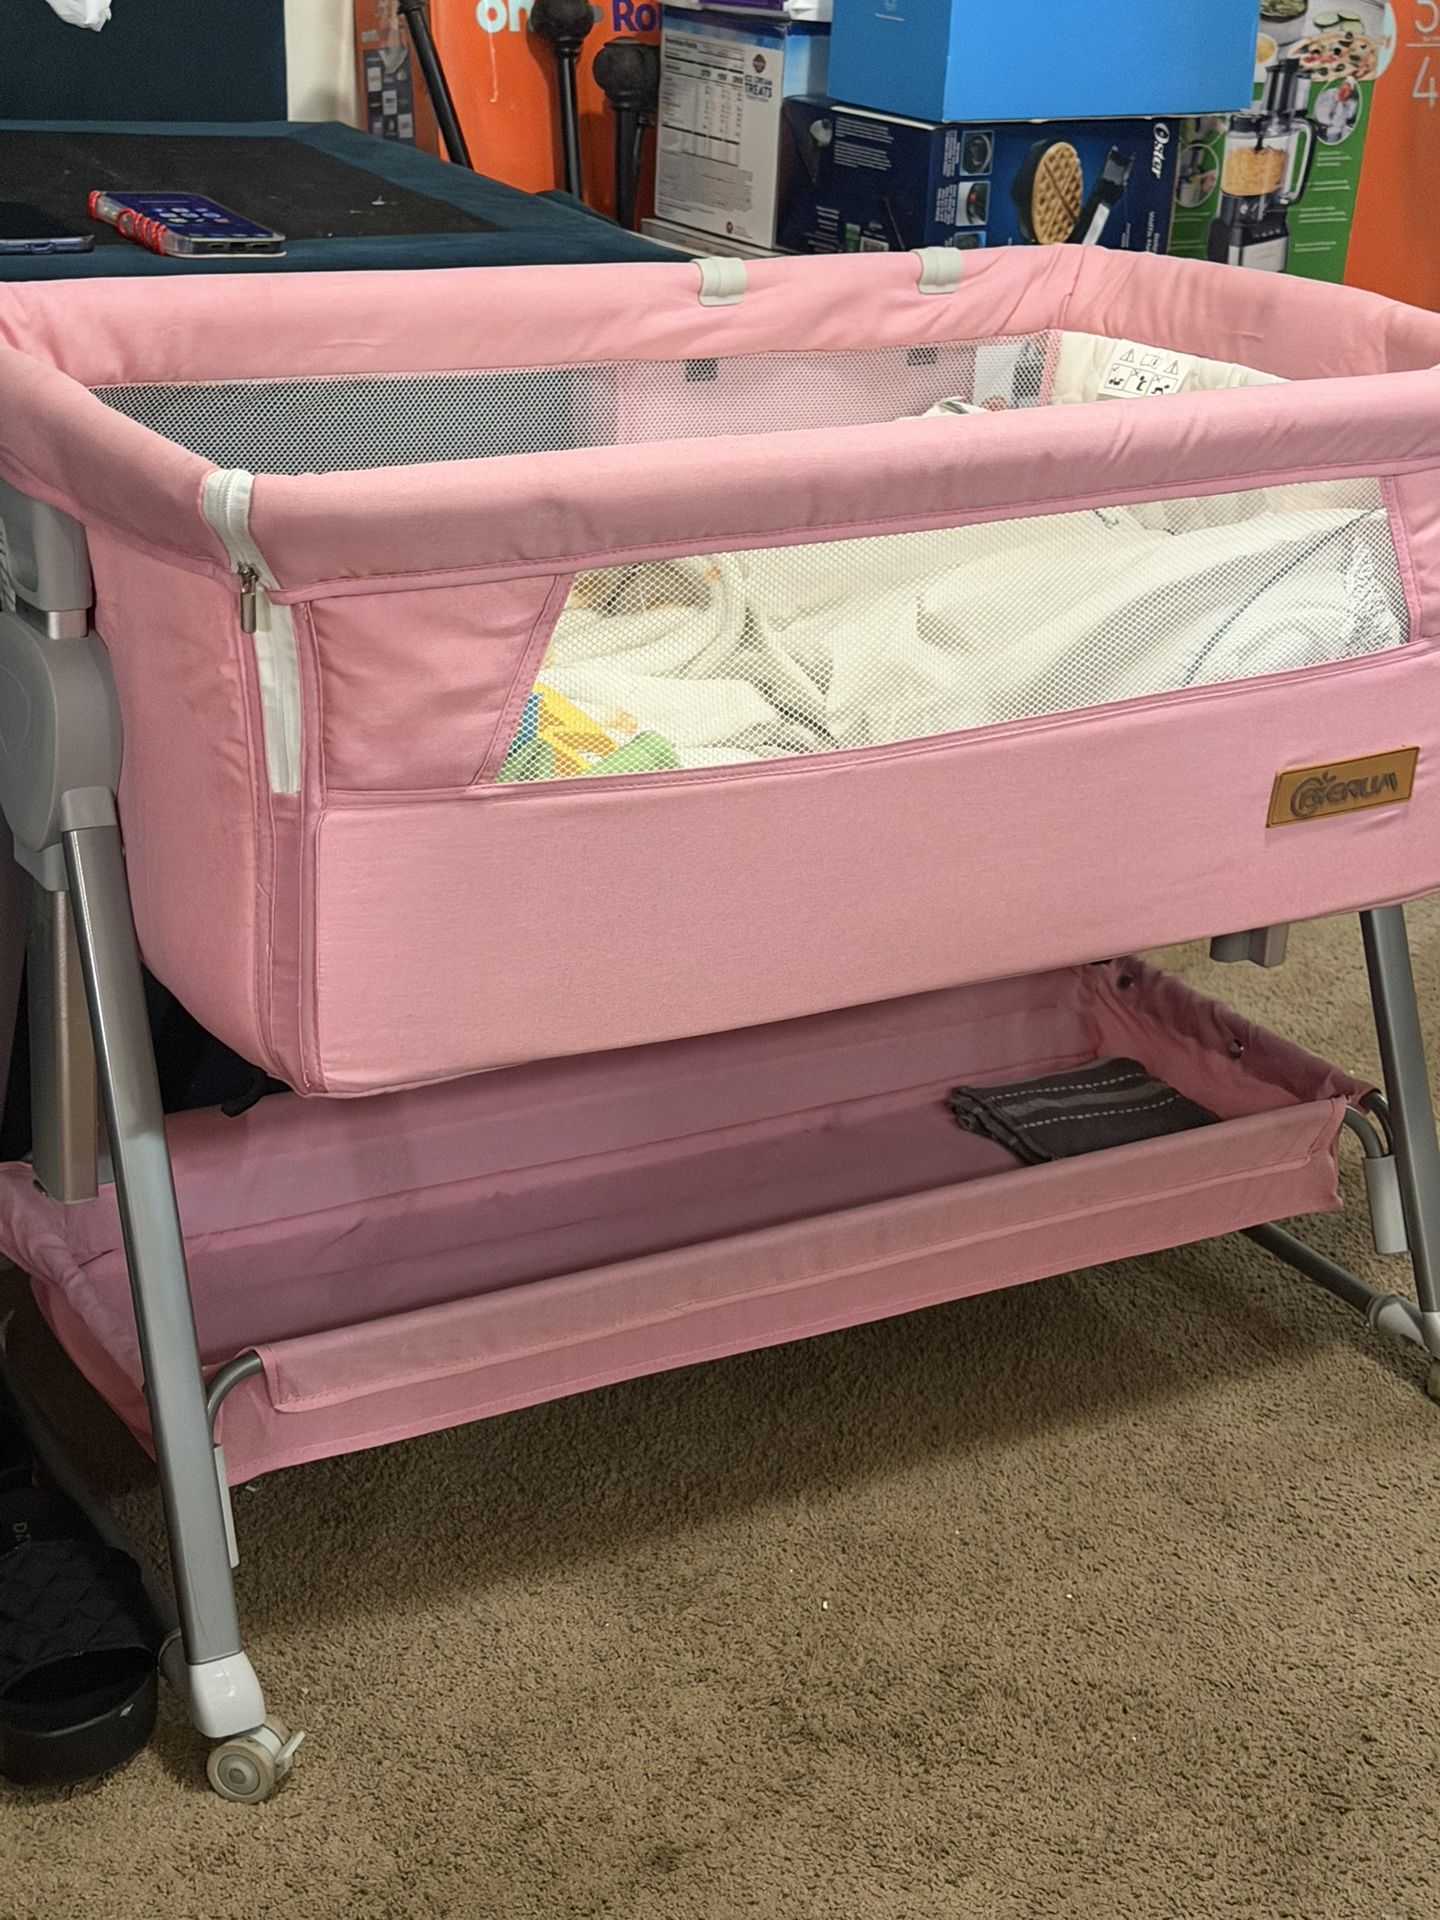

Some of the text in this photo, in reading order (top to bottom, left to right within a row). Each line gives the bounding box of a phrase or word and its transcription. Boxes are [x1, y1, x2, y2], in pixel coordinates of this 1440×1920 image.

[476, 0, 661, 33] on Ro
[744, 82, 773, 98] TREATS
[1151, 122, 1170, 179] Oster
